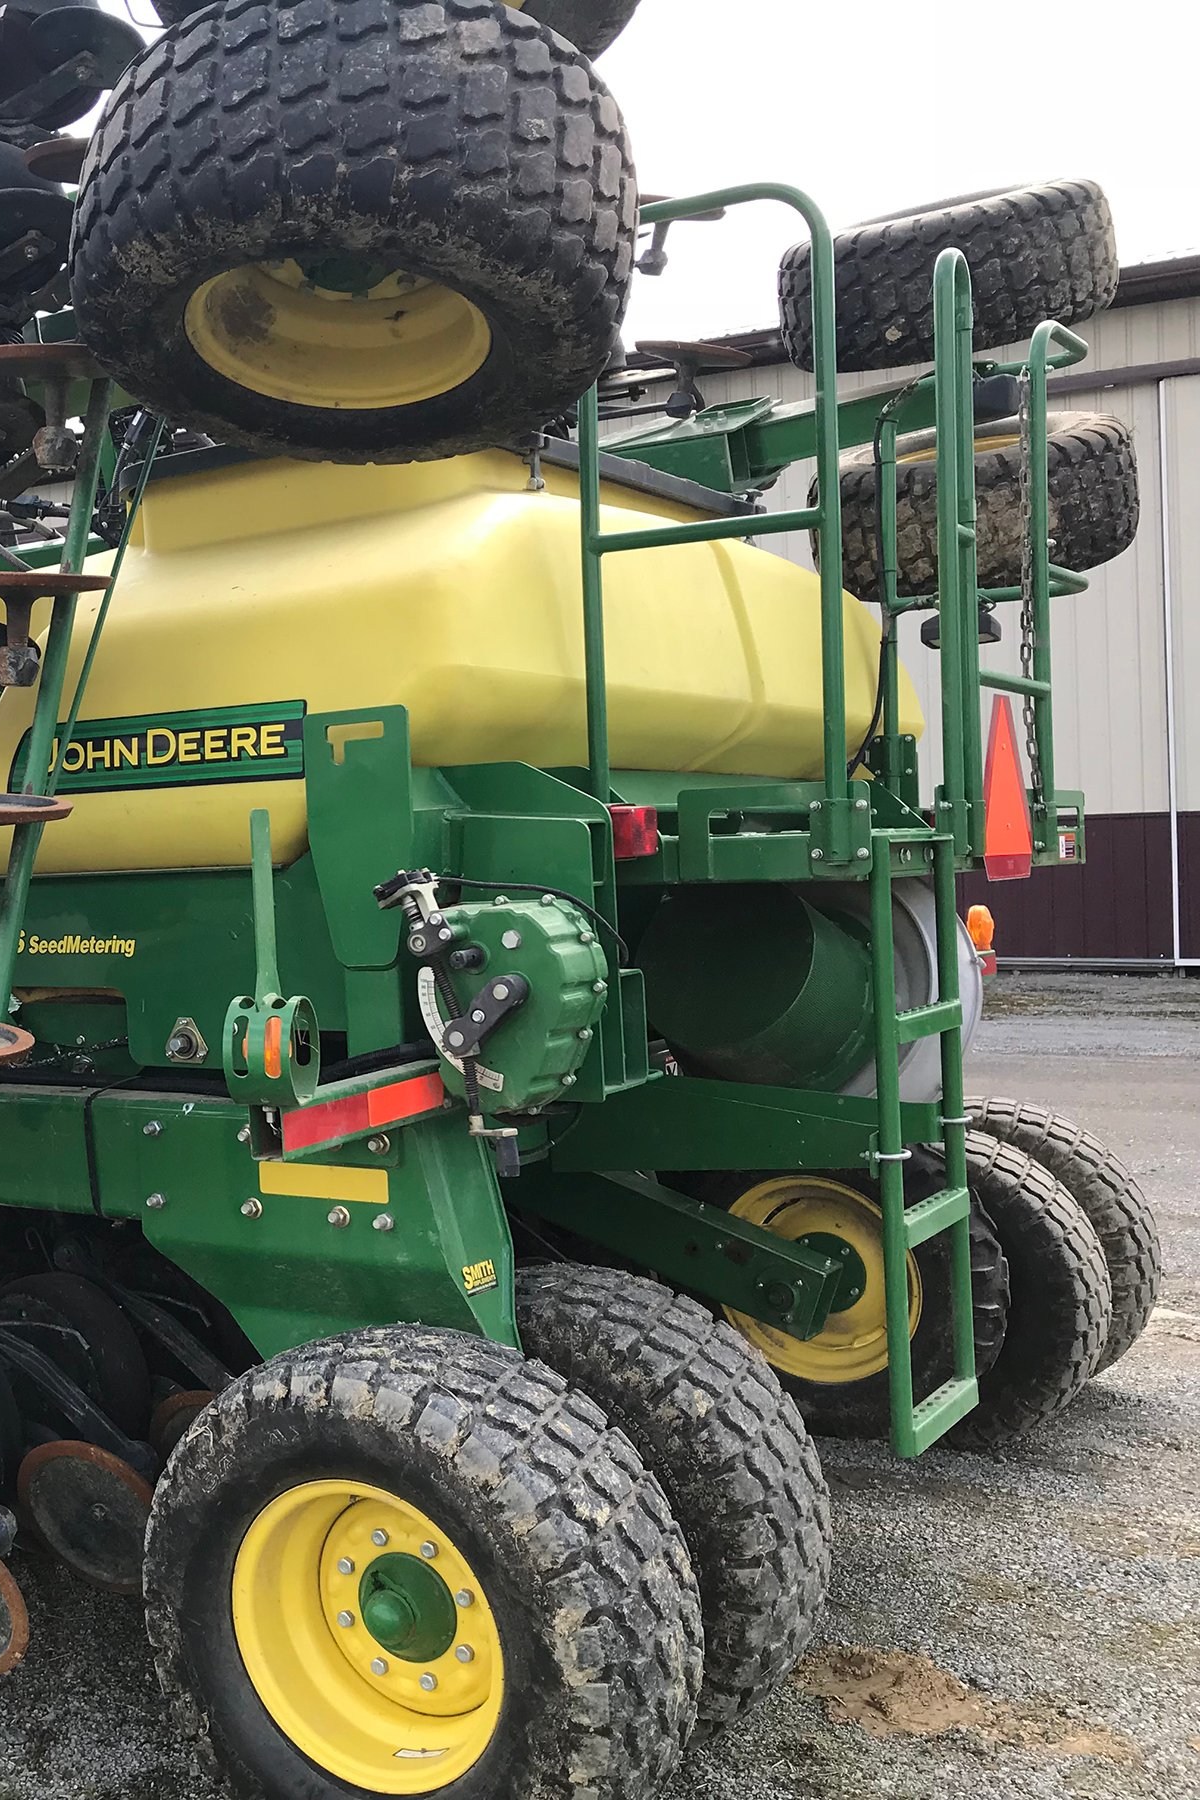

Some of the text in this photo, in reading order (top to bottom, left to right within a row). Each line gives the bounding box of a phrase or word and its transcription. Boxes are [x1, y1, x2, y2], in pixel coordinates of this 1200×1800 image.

[48, 724, 285, 772] JOHN DEERE
[29, 934, 136, 958] SeedMetering
[462, 1258, 495, 1290] SMITH
